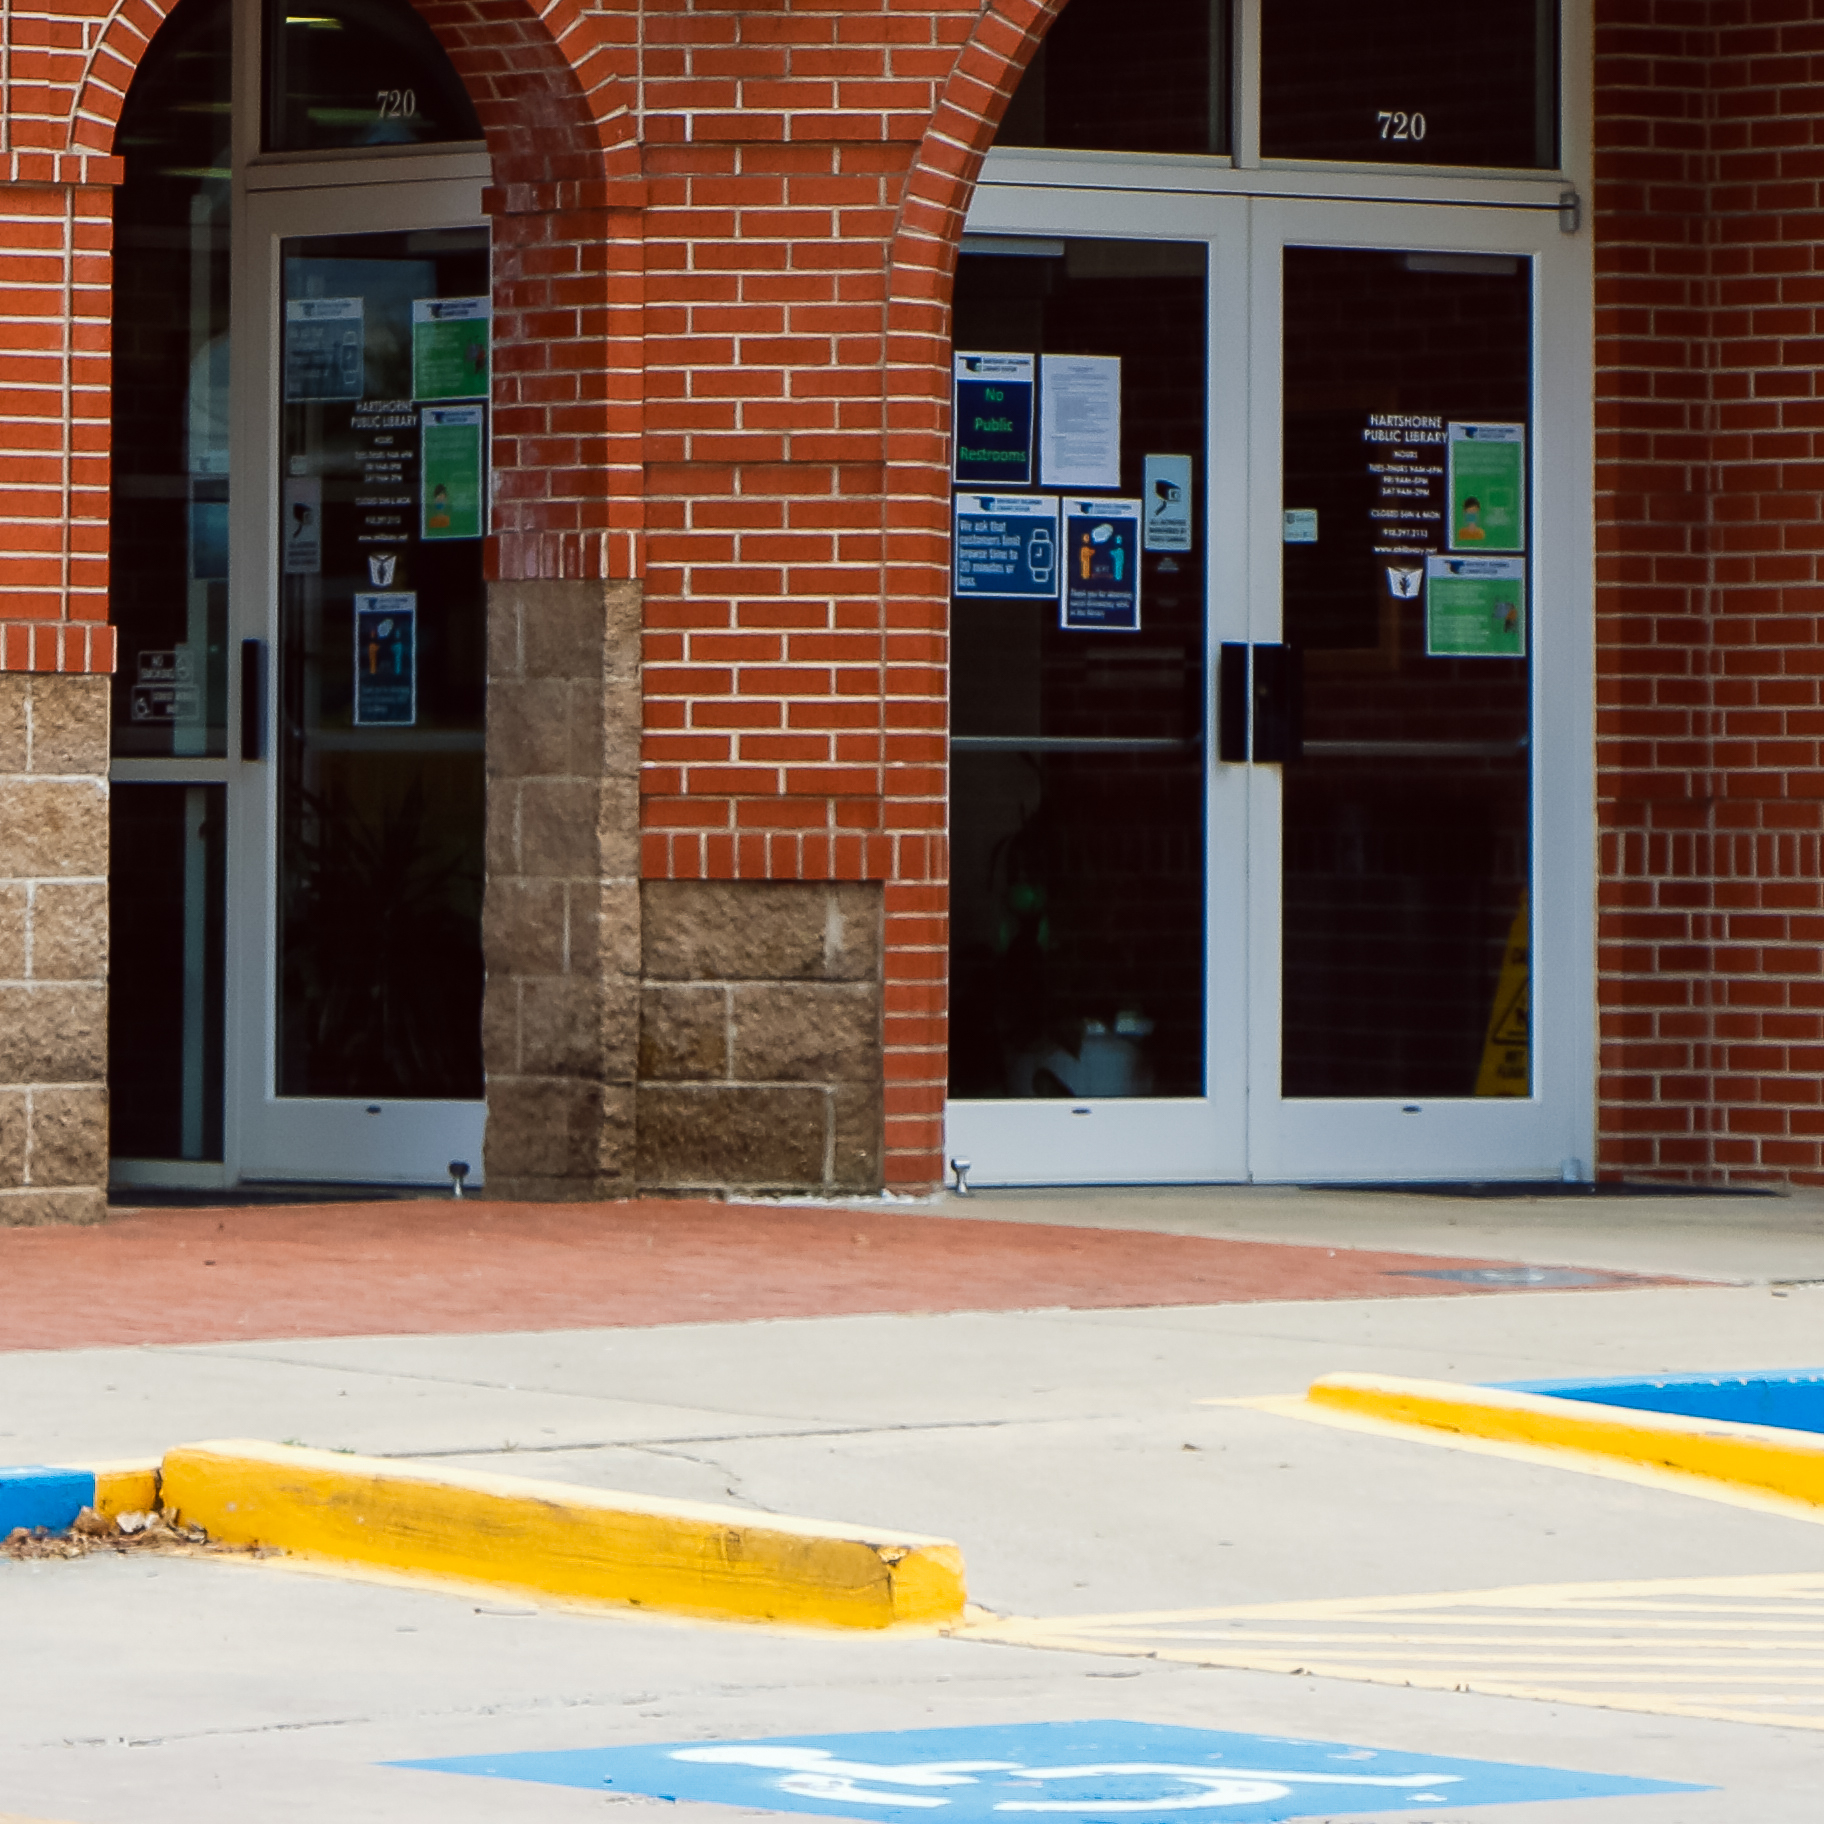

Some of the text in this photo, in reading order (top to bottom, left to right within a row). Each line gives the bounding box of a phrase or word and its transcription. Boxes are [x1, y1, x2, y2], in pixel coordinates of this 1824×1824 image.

[377, 89, 415, 118] 720
[1377, 111, 1426, 140] 720
[984, 387, 1005, 402] No
[382, 414, 418, 427] LIBRARY
[974, 417, 1014, 433] Public
[1370, 414, 1443, 429] HARTSHORNE
[1363, 429, 1448, 445] PUBLIC LIBRARY
[959, 446, 1027, 462] Restrooms
[959, 519, 1007, 533] We ask that
[1002, 535, 1021, 547] limit
[989, 549, 1008, 560] time
[1009, 549, 1019, 560] to
